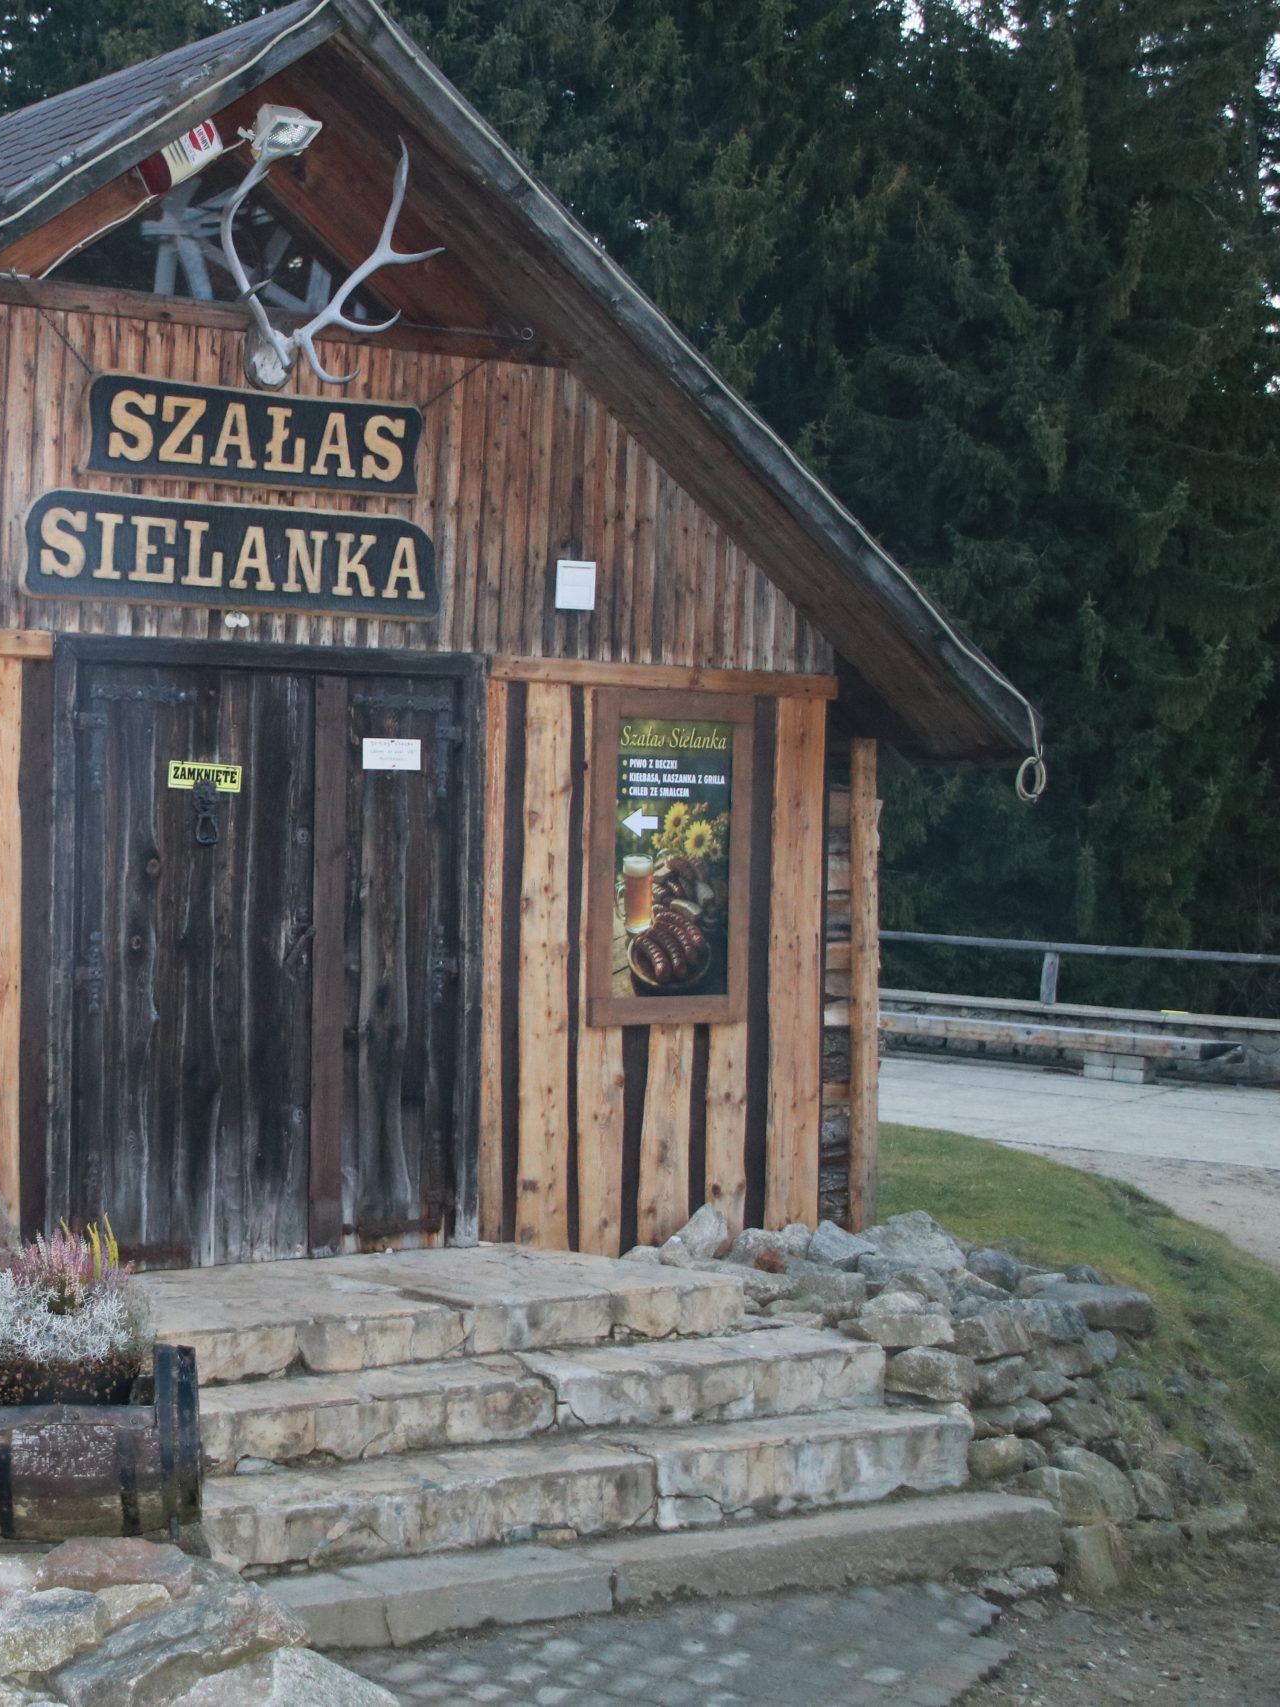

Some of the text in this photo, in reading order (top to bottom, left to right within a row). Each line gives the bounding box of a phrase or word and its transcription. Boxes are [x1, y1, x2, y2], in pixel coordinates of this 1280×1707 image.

[108, 389, 406, 483] SZAŁAS
[39, 507, 425, 600] SIELANKA
[620, 725, 727, 750] Szałas Sielanka
[629, 758, 678, 769] PIWO Z BECZKI
[173, 766, 237, 785] ZAMKNIĘTE
[662, 774, 696, 784] KASZANKA
[698, 774, 702, 784] Z
[704, 775, 725, 784] GRILLA
[629, 786, 690, 797] CHLEB ZE SMALCEM
